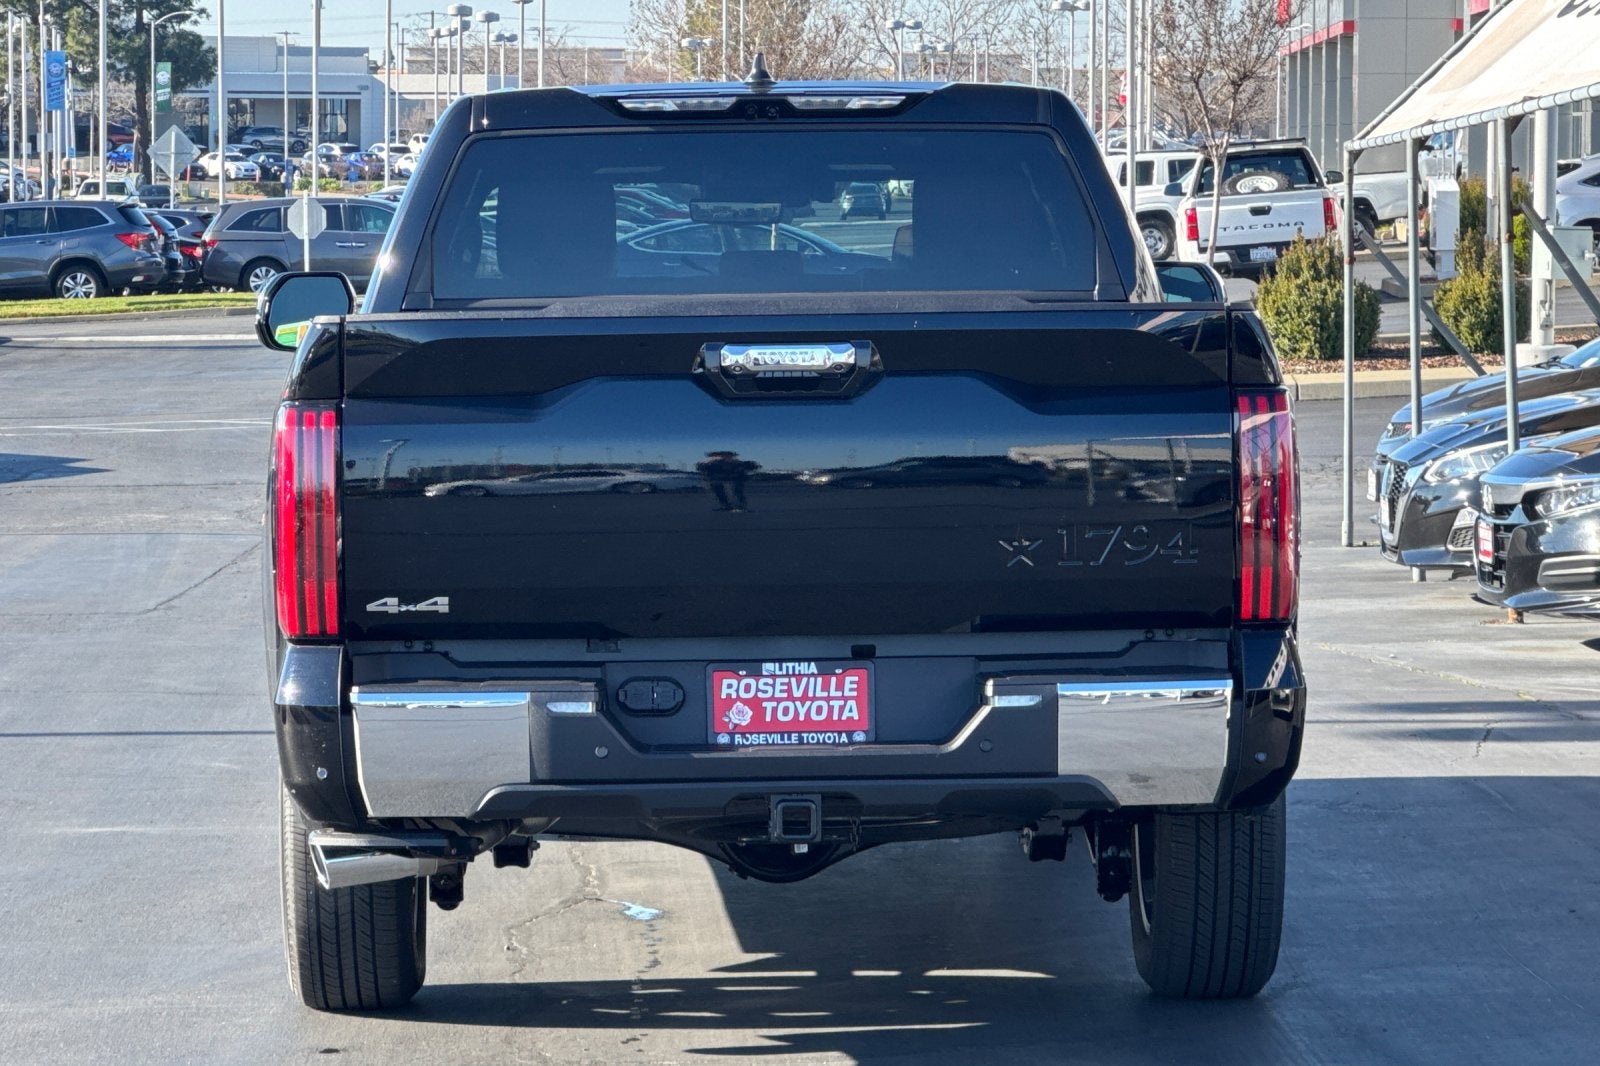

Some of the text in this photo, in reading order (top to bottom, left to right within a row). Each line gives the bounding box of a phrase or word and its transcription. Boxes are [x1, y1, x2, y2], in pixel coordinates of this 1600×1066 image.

[1219, 220, 1305, 232] TACOMA
[757, 350, 820, 366] TOYOTA
[1056, 524, 1199, 566] 1794
[774, 662, 818, 675] LITHIA
[720, 676, 859, 699] ROSEVILLE
[762, 699, 860, 722] TOYOTA
[734, 732, 848, 745] ROSEVILLE TOYOTA
